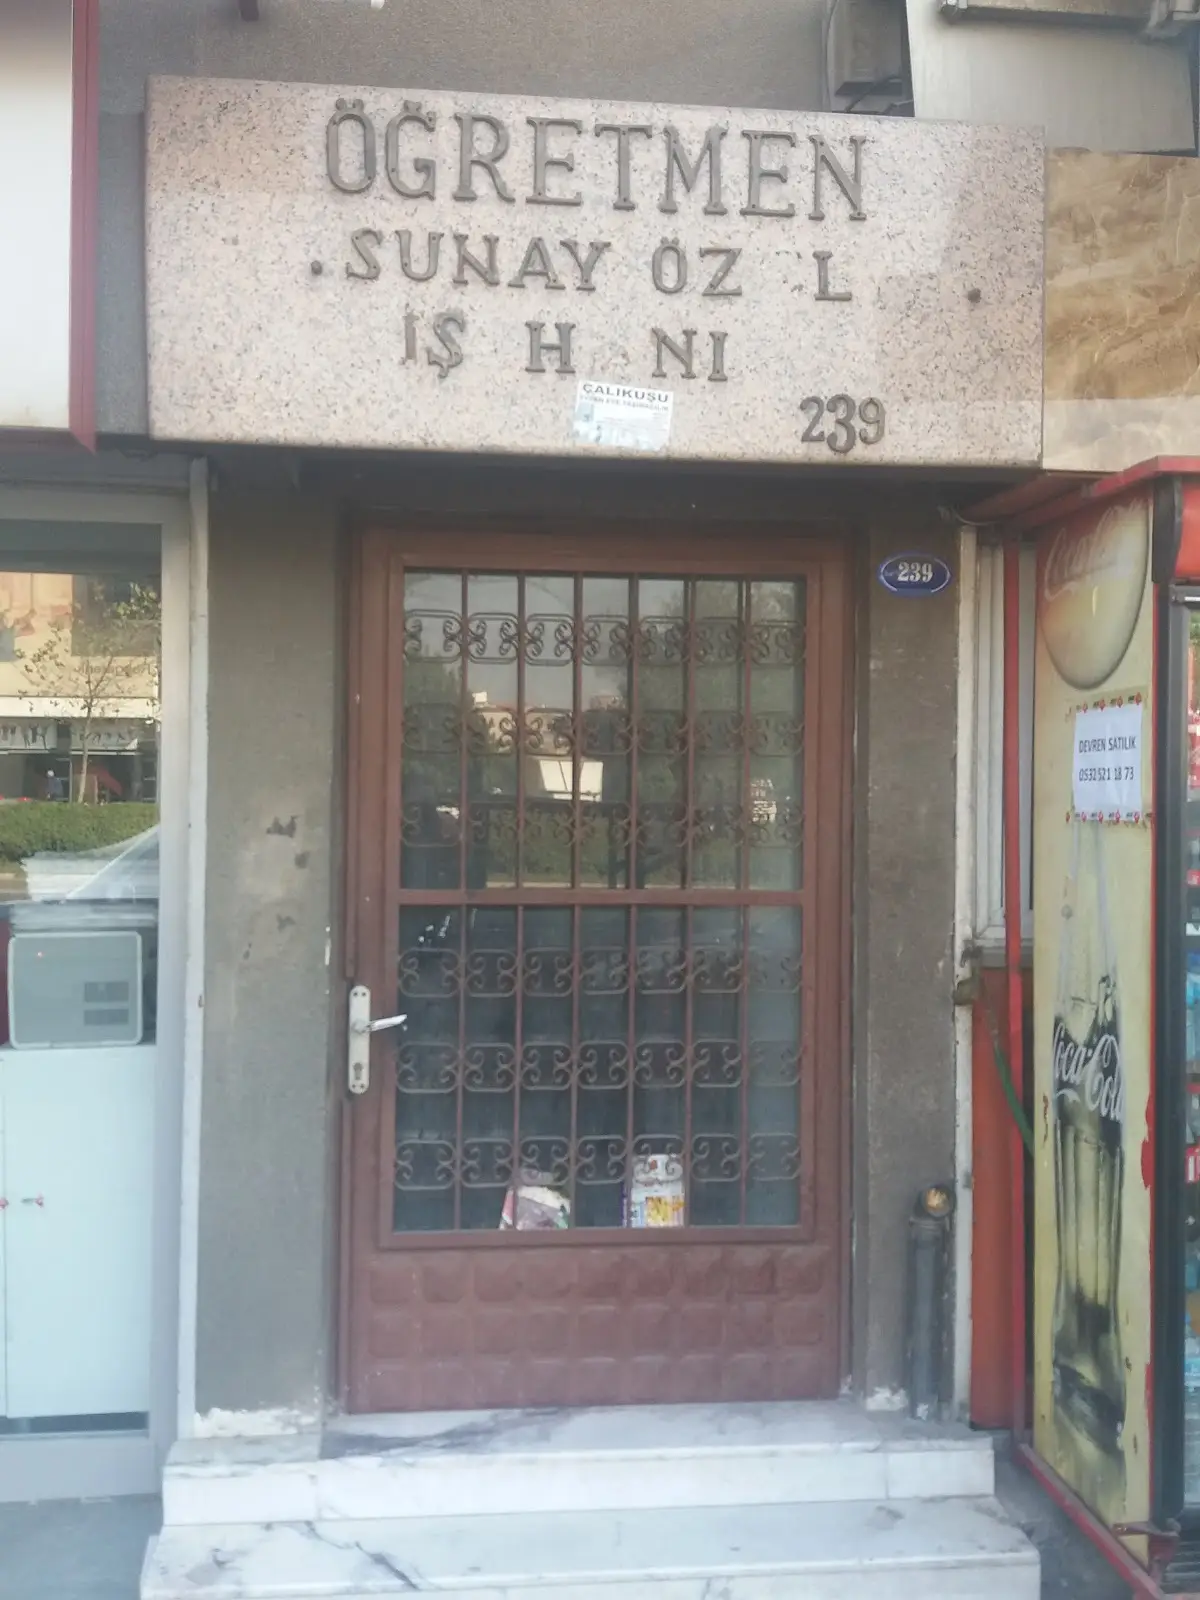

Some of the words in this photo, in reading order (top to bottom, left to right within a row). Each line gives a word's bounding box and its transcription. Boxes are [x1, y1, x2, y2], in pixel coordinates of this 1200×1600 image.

[325, 97, 867, 221] ÖĞRETMEN
[345, 228, 611, 291] SUNAY
[799, 392, 886, 454] 239
[897, 561, 934, 583] 239
[1078, 738, 1106, 754] DEVREN
[1124, 765, 1135, 781] 73
